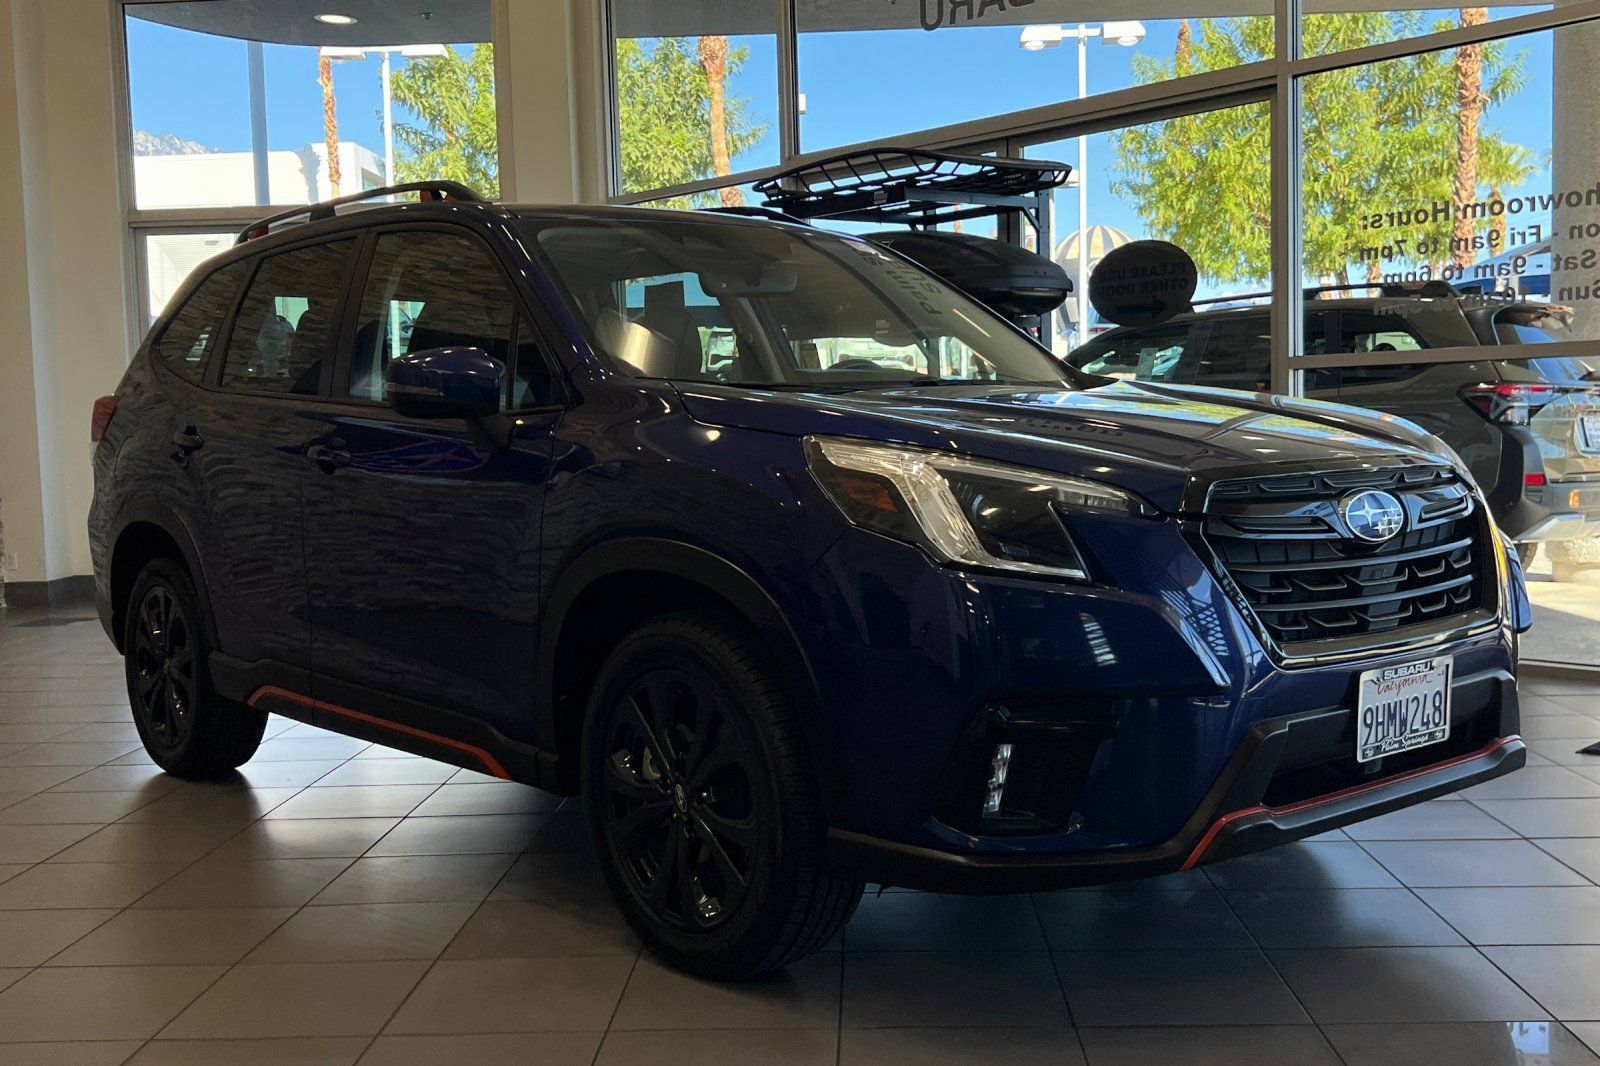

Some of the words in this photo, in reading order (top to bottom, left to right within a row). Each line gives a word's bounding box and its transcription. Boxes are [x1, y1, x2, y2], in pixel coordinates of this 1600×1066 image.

[1384, 661, 1431, 680] SUBARU
[1363, 689, 1443, 747] 9HMW248
[1381, 737, 1399, 752] Palm
[1401, 733, 1429, 748] Springs
